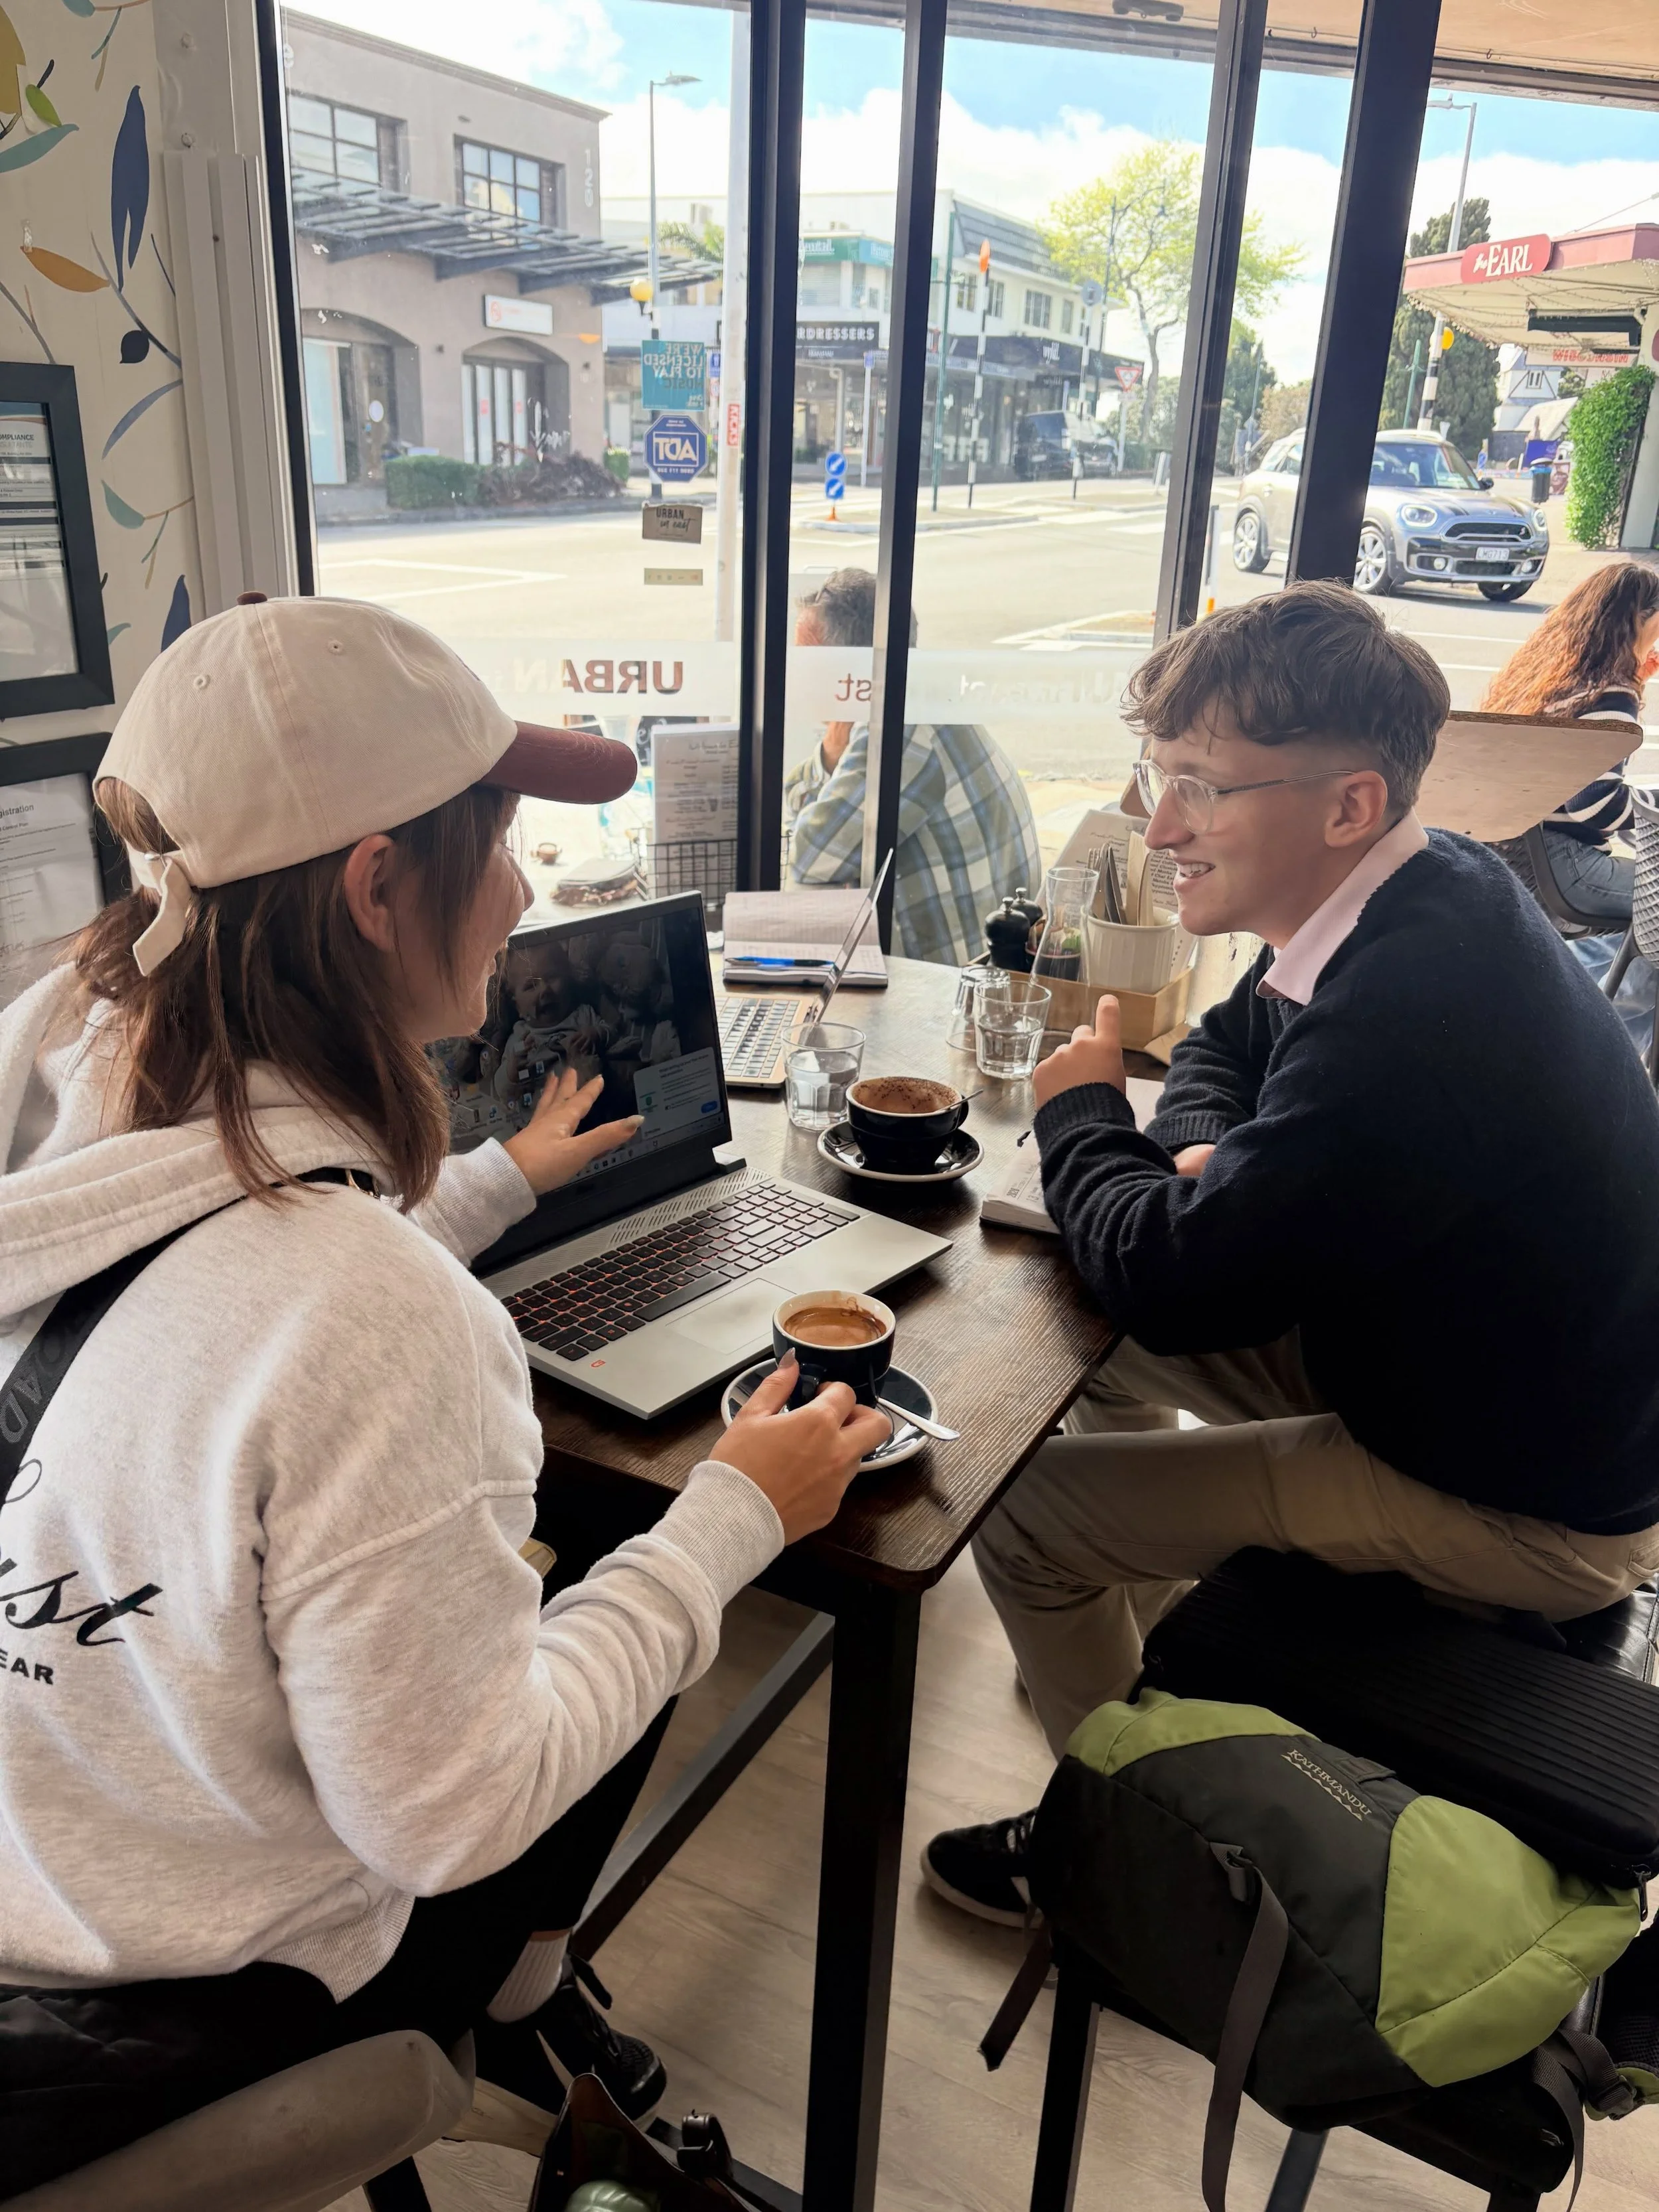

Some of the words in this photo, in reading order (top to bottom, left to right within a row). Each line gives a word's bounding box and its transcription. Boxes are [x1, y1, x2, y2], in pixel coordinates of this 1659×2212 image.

[1486, 244, 1533, 277] EARL
[656, 508, 684, 519] URBAN
[0, 1568, 163, 1646] st
[1287, 1749, 1372, 1815] KATHMANDU
